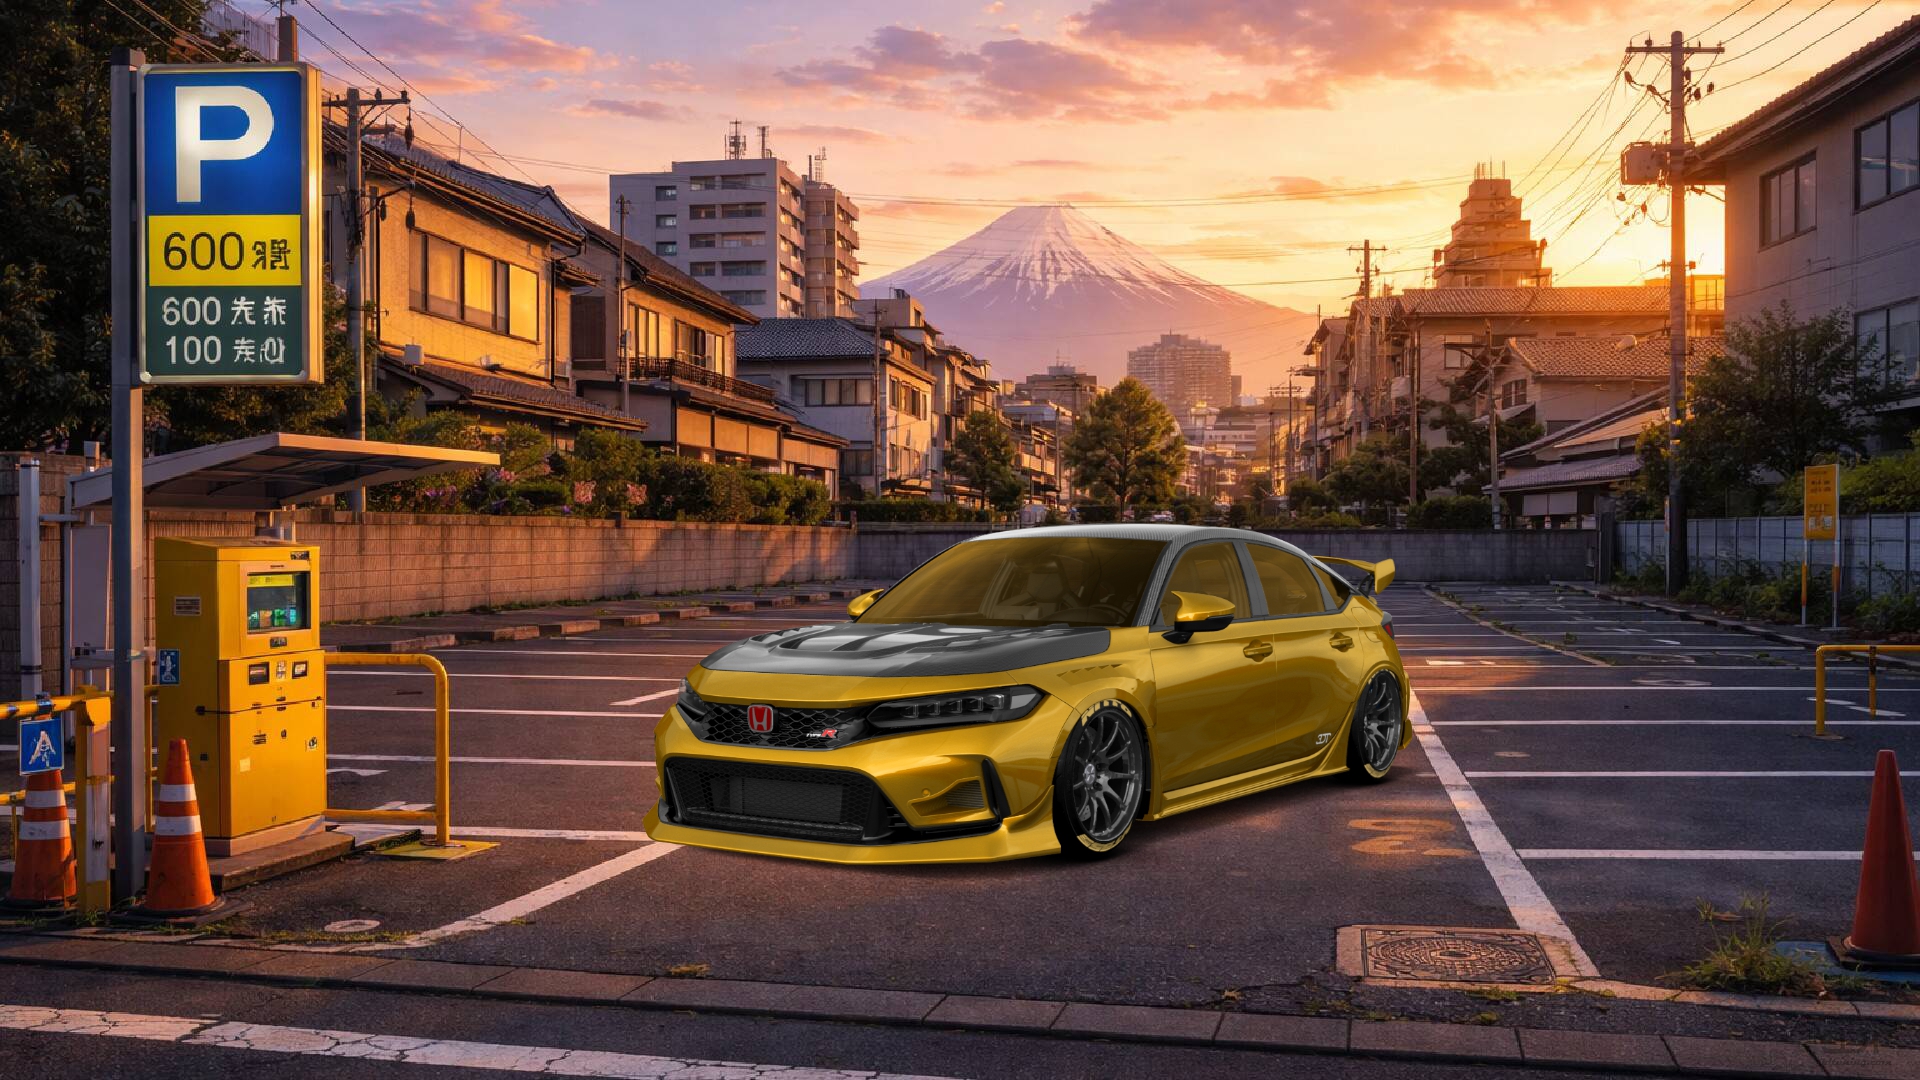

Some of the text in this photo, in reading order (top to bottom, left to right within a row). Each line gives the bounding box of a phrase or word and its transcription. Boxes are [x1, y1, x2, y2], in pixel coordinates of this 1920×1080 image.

[175, 86, 274, 202] P
[163, 232, 244, 271] 600
[162, 297, 221, 326] 600
[166, 336, 222, 364] 100
